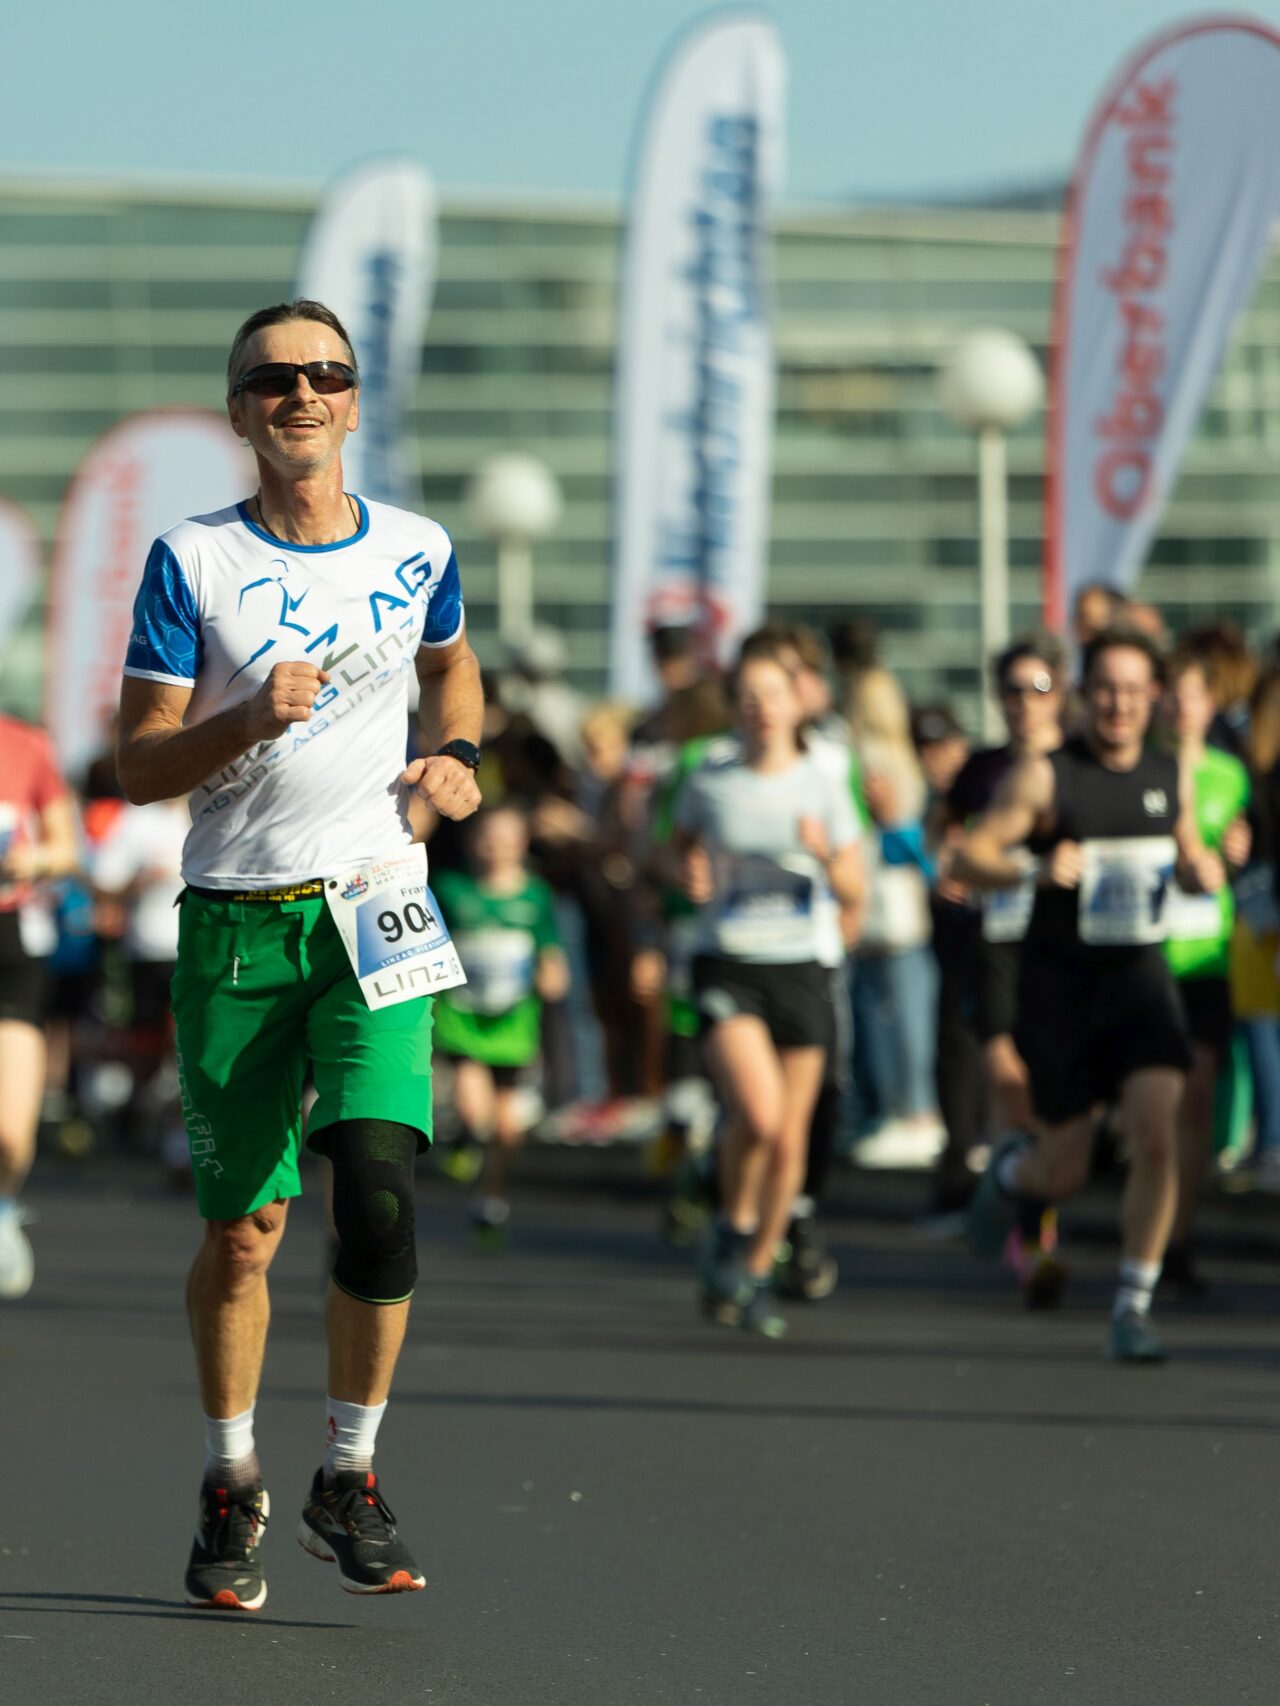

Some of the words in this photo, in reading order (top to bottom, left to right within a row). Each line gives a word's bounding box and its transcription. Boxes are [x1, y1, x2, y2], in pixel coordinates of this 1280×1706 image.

[1092, 72, 1179, 524] Oberbank
[368, 551, 432, 634] AG
[373, 960, 449, 997] LINZ
